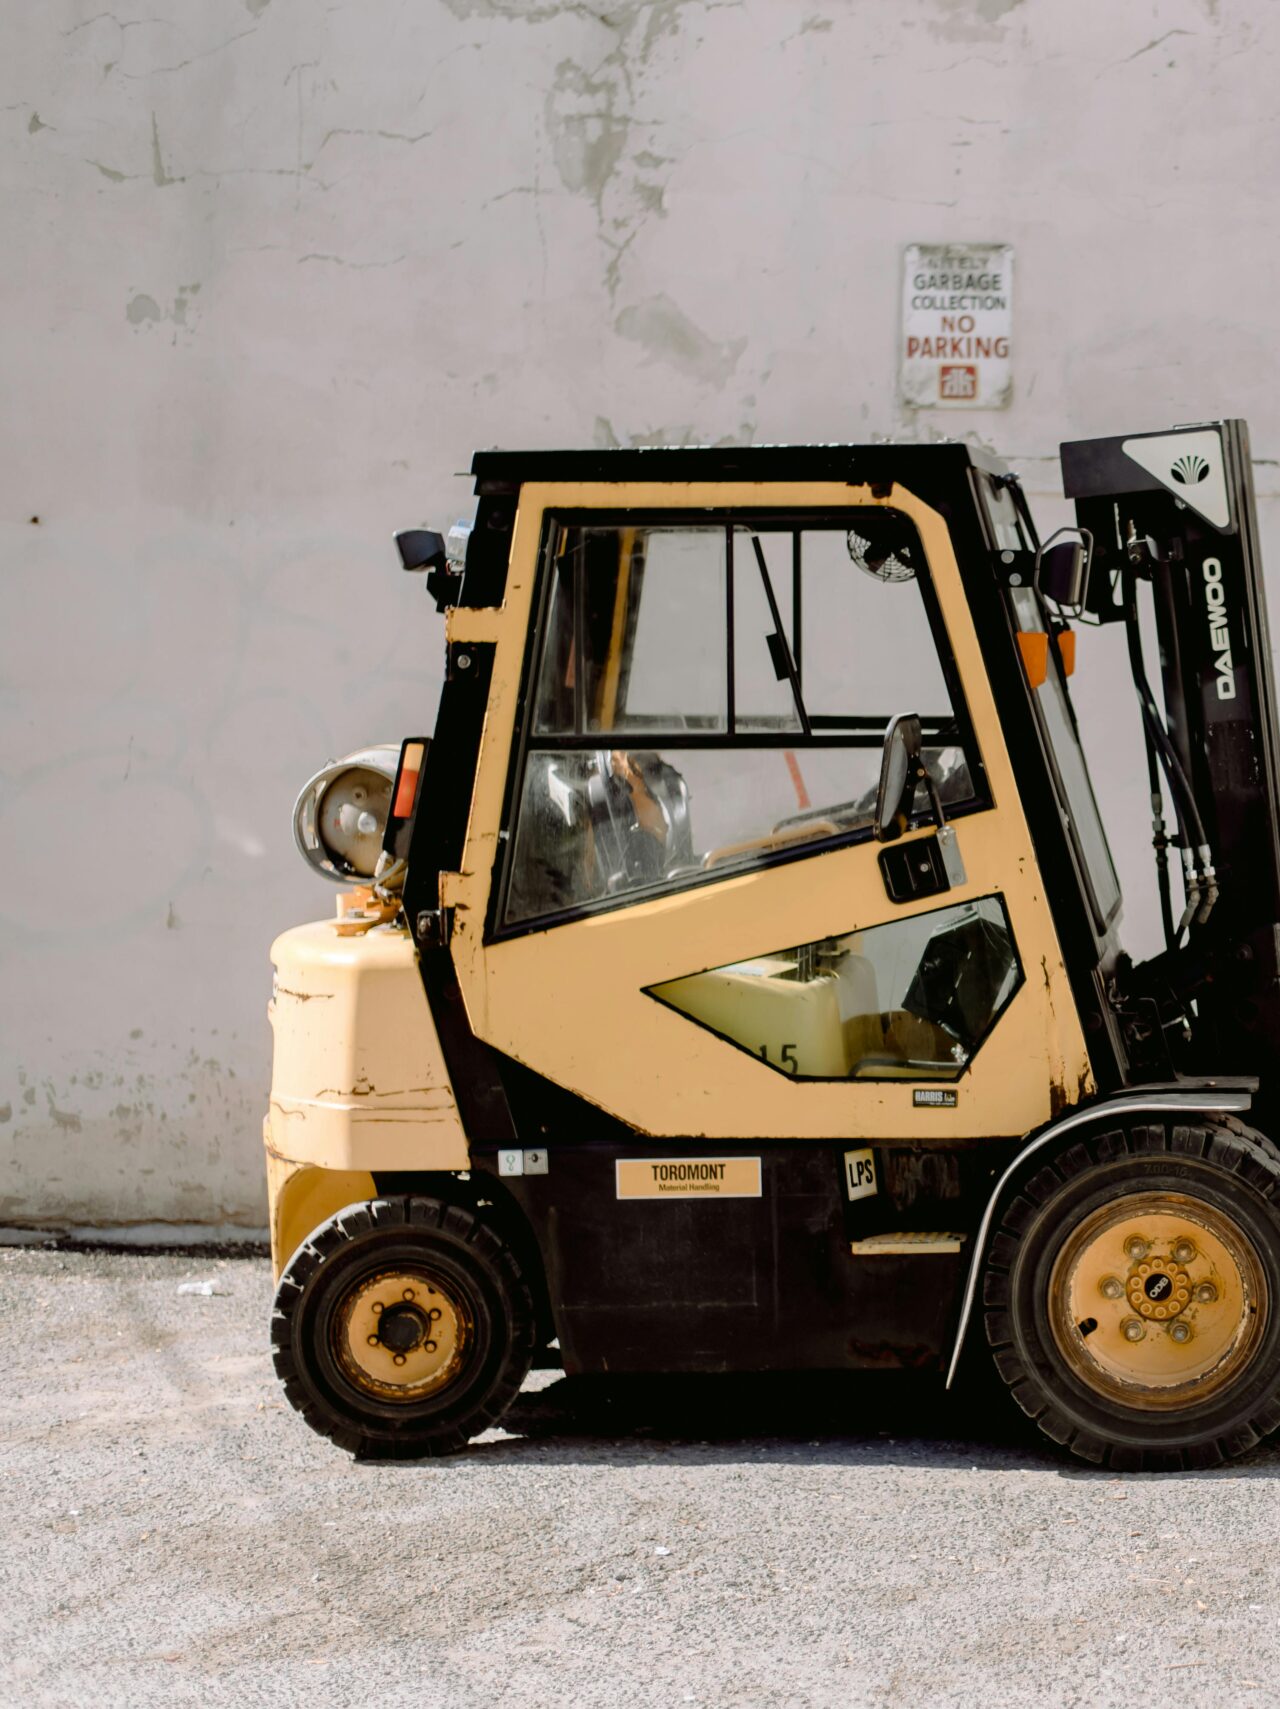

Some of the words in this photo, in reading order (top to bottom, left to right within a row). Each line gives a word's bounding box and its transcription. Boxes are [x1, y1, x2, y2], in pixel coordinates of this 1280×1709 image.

[913, 273, 1002, 291] GARBAGE
[911, 295, 1006, 311] COLLECTION
[941, 315, 975, 333] NO
[906, 337, 1010, 359] PARKING
[1202, 557, 1236, 700] DAEWOO
[915, 1091, 943, 1102] HARRIS
[651, 1164, 726, 1181] TOROMONT
[848, 1159, 873, 1188] LPS
[658, 1183, 688, 1192] Material
[689, 1183, 720, 1192] Handling
